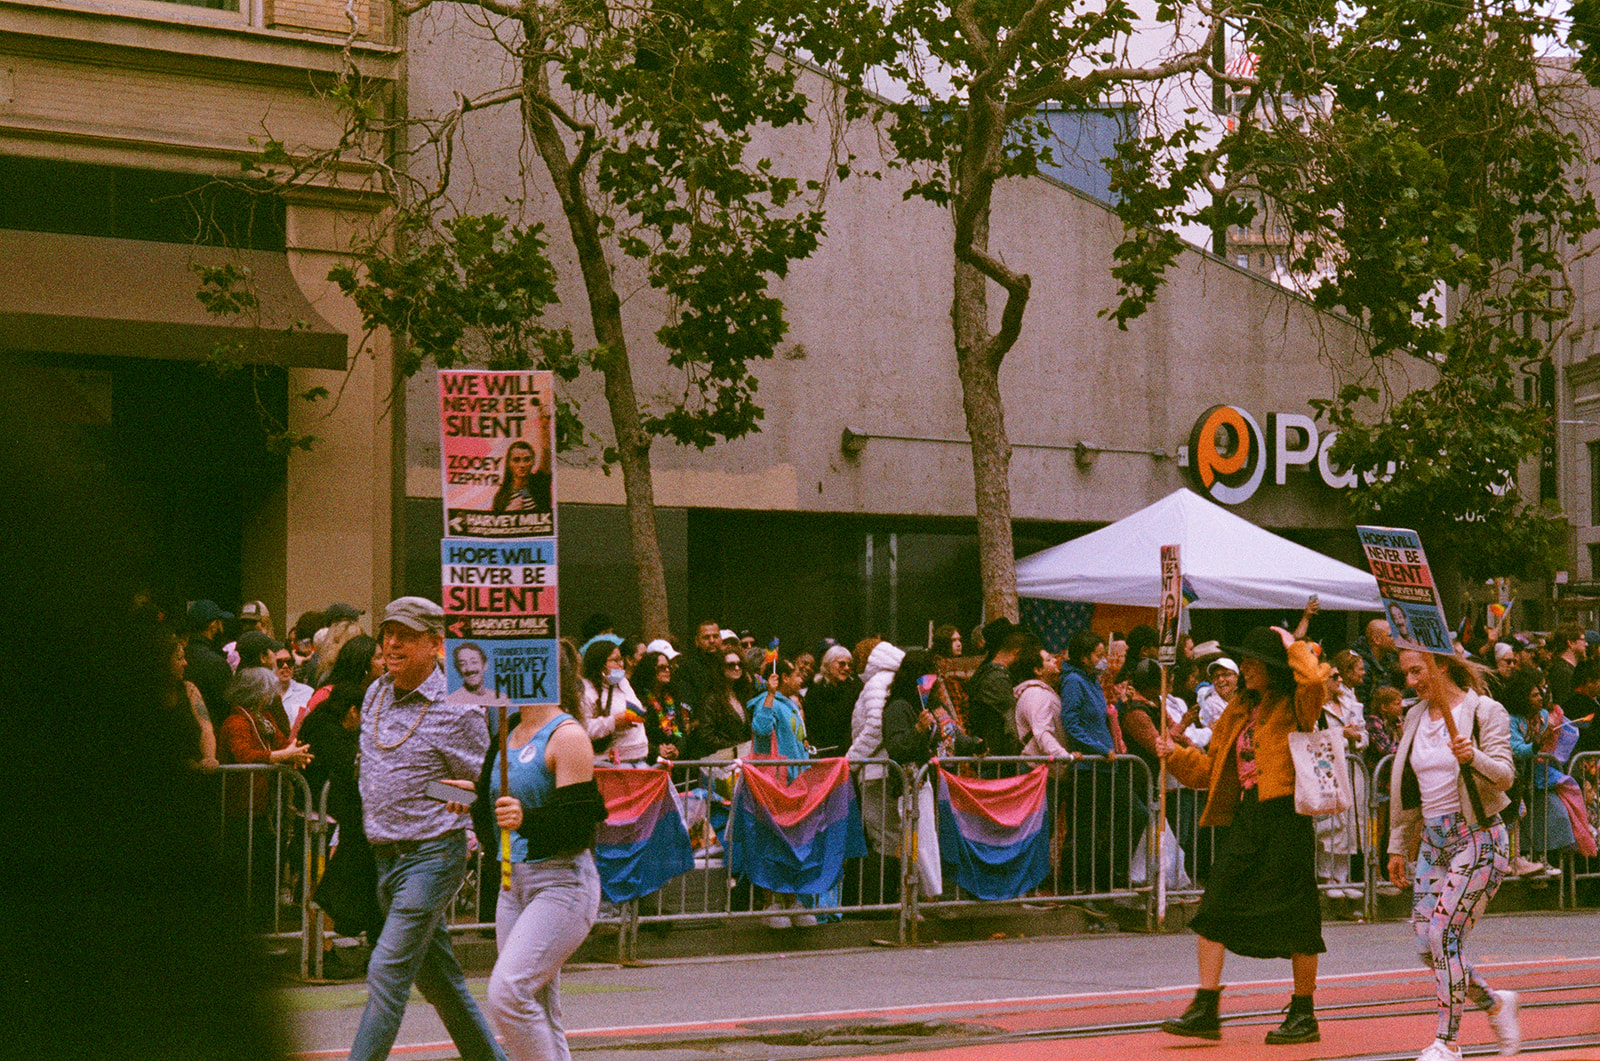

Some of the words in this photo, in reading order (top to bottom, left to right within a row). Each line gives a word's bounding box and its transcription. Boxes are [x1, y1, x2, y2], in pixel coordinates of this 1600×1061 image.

[441, 374, 478, 396] WE
[484, 374, 540, 396] WILL
[443, 396, 499, 413] NEVER
[504, 397, 526, 413] BE
[446, 415, 526, 438] SILENT
[447, 454, 503, 471] ZOOEY
[448, 471, 500, 486] ZEPHYR
[466, 514, 518, 527] HARVEY
[519, 513, 552, 526] MILK
[1361, 532, 1390, 546] HOPE
[1390, 535, 1417, 549] WILL
[449, 546, 498, 564] HOPE
[501, 547, 547, 564] WILL
[1367, 546, 1402, 562] NEVER
[1404, 550, 1421, 564] BE
[450, 566, 513, 584] NEVER
[523, 567, 546, 584] BE
[1373, 561, 1423, 584] SILENT
[449, 586, 544, 612] SILENT
[471, 617, 518, 629] HARVEY
[519, 617, 549, 628] MILK
[1412, 627, 1448, 649] MILK
[493, 656, 549, 673] HARVEY
[495, 672, 548, 699] MILK
